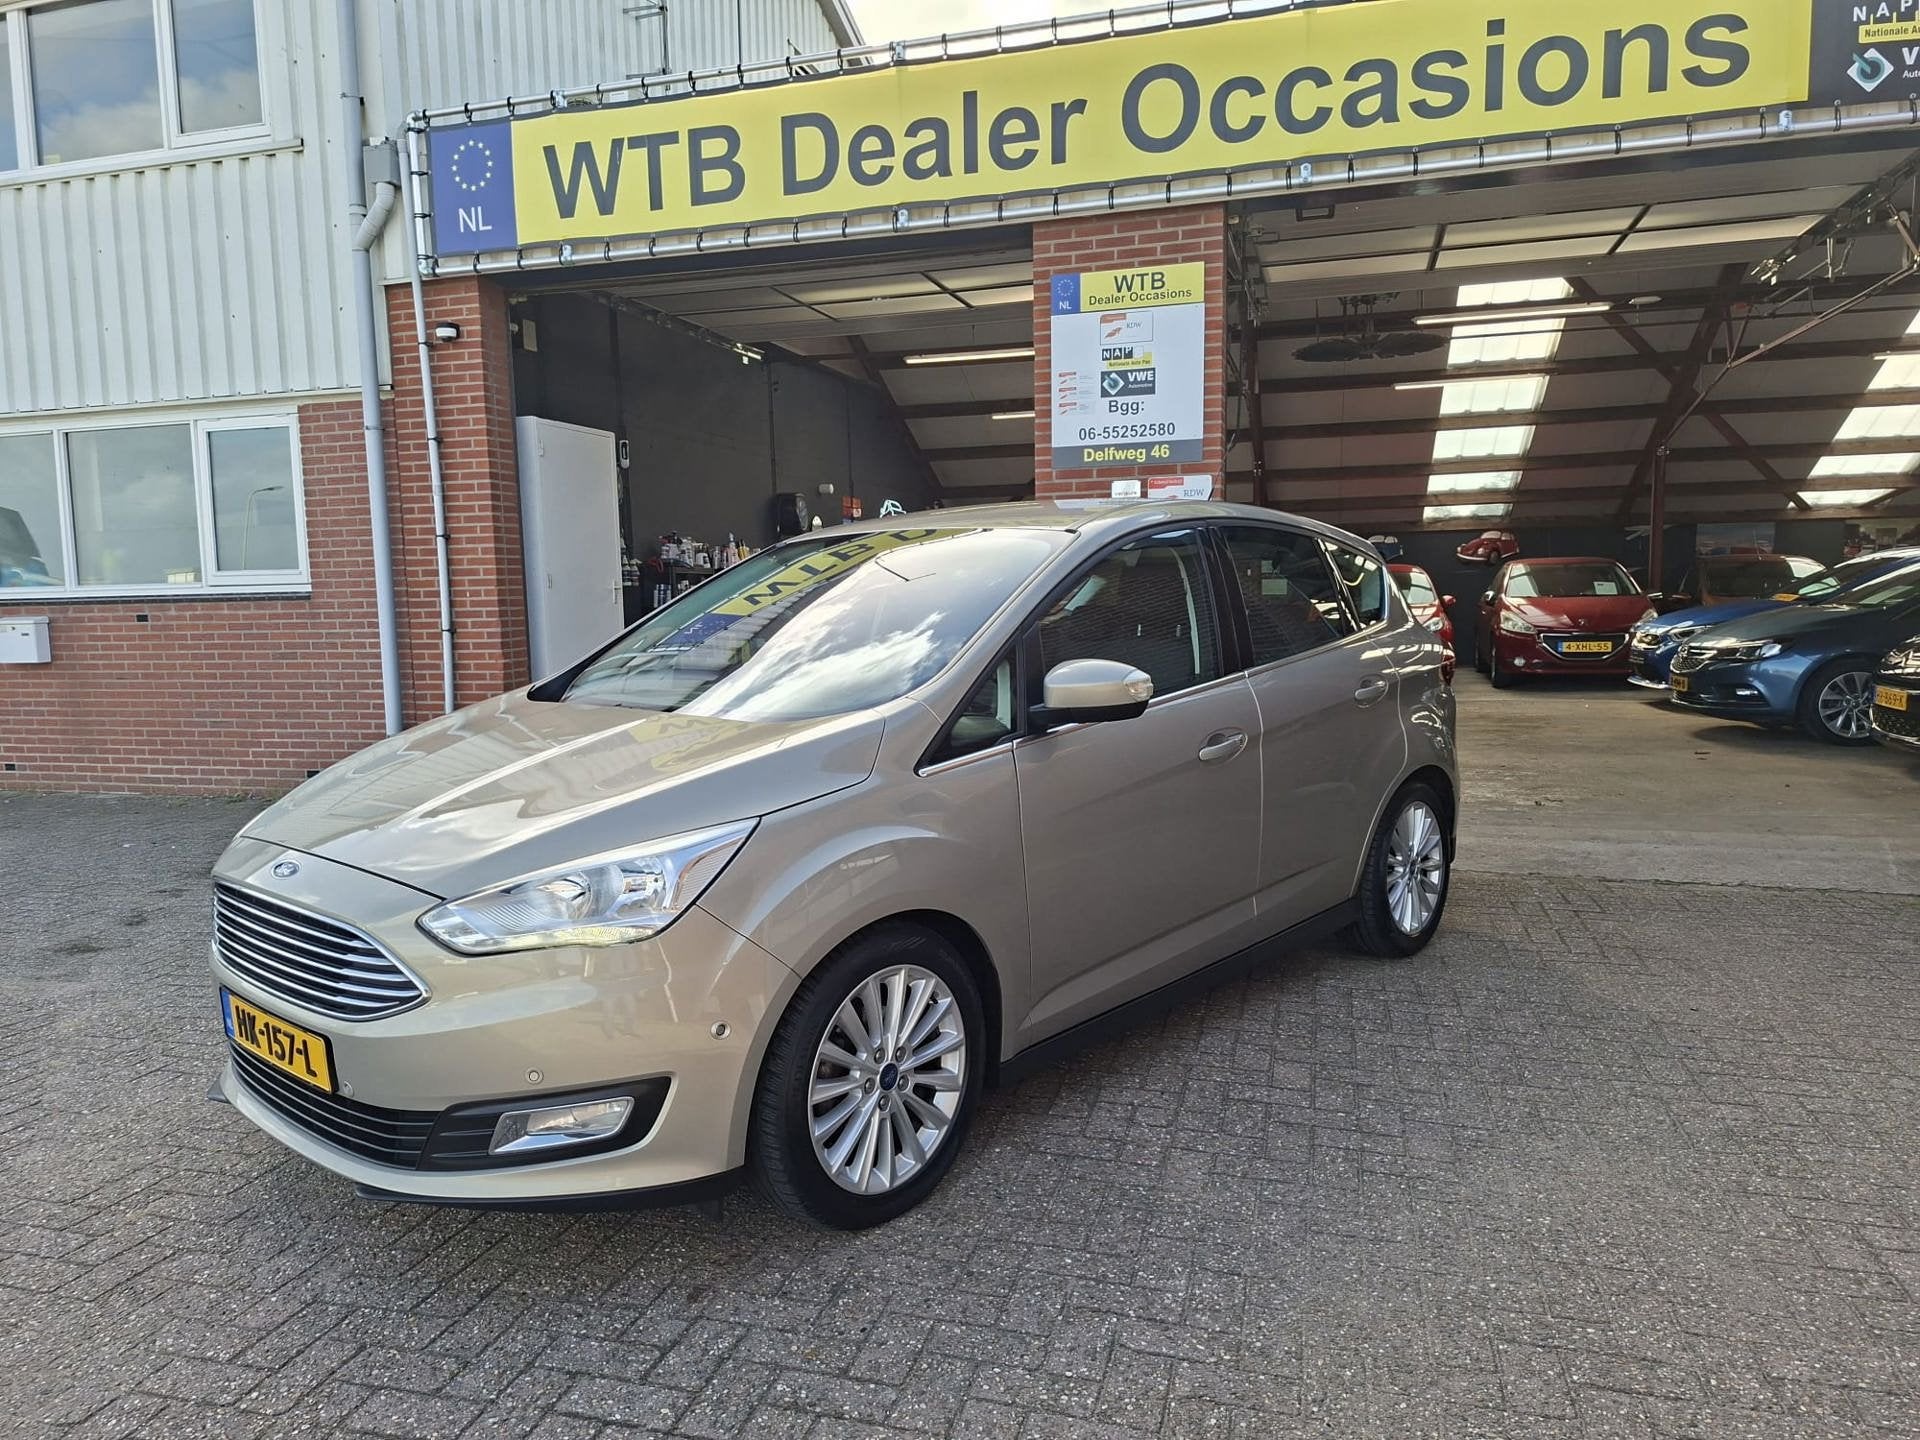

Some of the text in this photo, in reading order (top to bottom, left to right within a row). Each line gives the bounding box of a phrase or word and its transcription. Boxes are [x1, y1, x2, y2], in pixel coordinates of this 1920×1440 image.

[1864, 26, 1909, 38] Nationale
[543, 13, 1752, 220] WTB Dealer Occasions
[458, 206, 492, 234] NL
[1114, 271, 1166, 293] WTB
[1059, 301, 1072, 310] NL
[1089, 289, 1192, 306] Dealer Occasions
[1103, 347, 1132, 359] NAP
[1128, 371, 1154, 382] VWE
[1109, 399, 1145, 415] Bgg:
[1079, 422, 1175, 441] 06-55252580
[1083, 444, 1169, 463] Delfweg 46
[1184, 488, 1205, 497] RDW
[1566, 642, 1609, 651] 4-XHL-55
[235, 1005, 318, 1078] HK-157-L
